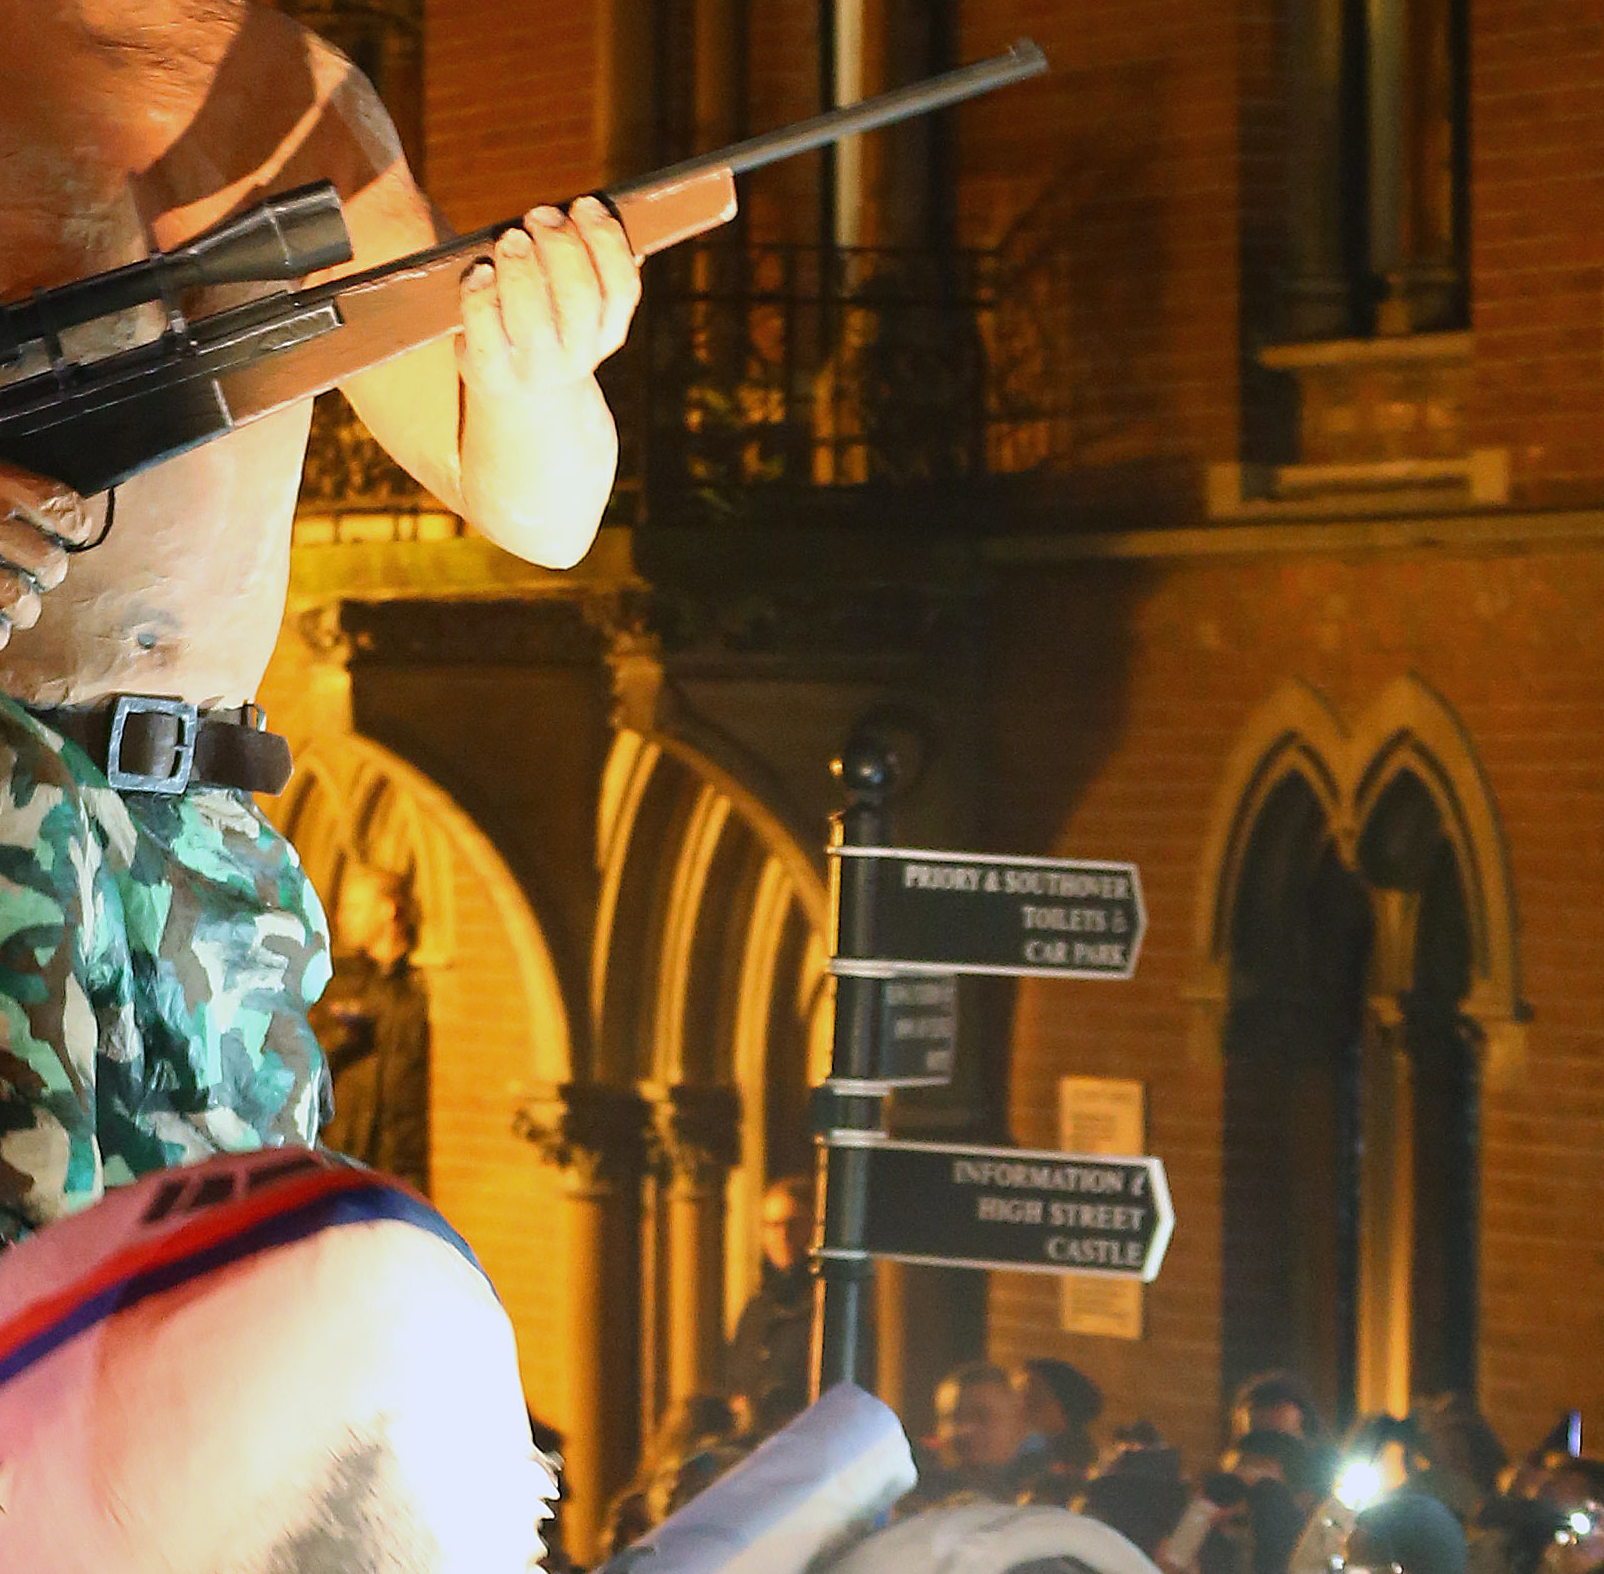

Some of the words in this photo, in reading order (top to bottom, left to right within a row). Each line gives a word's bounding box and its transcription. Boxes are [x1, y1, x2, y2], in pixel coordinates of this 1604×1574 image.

[905, 863, 980, 891] PRIORY
[1004, 870, 1131, 900] SOUTHOVER
[1022, 905, 1107, 931] TOILETS
[1025, 939, 1068, 964] CAR
[1073, 941, 1128, 967] PARK
[953, 1160, 1124, 1194] INFORMATION
[977, 1197, 1044, 1225] HIGH
[1049, 1202, 1146, 1231] STREET
[1046, 1236, 1146, 1268] CASTLE
